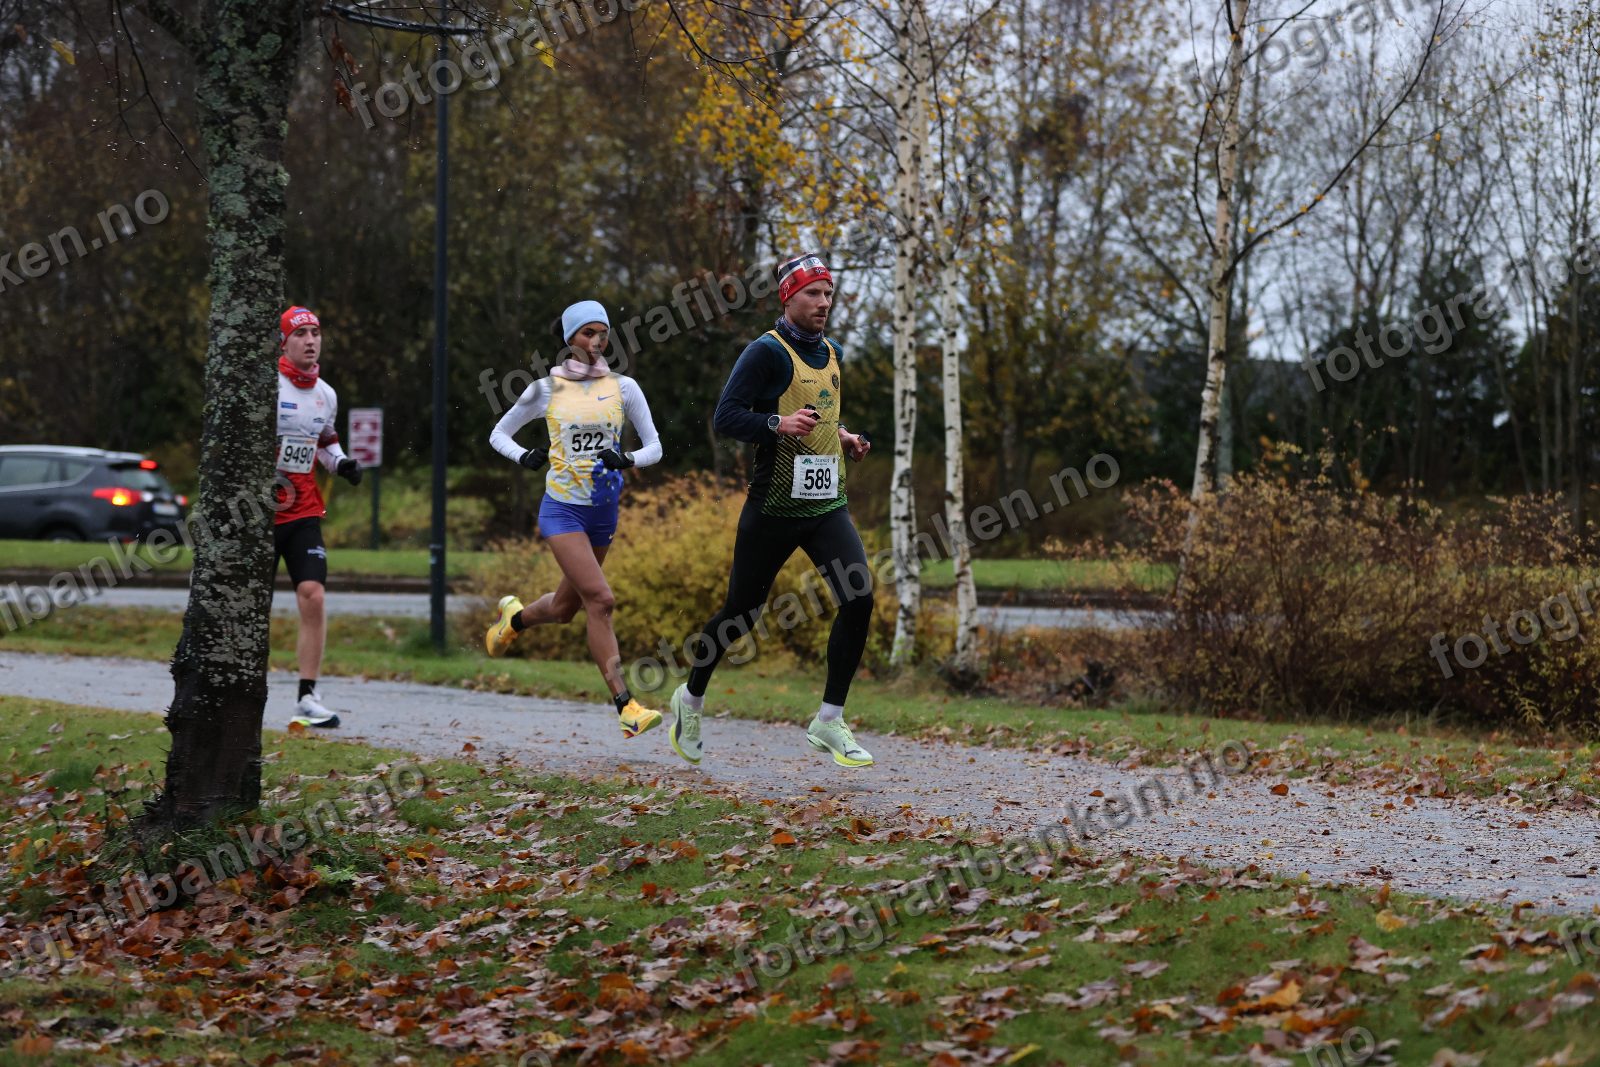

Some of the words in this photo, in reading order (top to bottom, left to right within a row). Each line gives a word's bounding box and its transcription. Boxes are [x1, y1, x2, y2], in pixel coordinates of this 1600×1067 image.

[290, 313, 308, 327] NES
[572, 432, 604, 452] 522
[283, 446, 313, 464] 9490
[804, 467, 831, 490] 589
